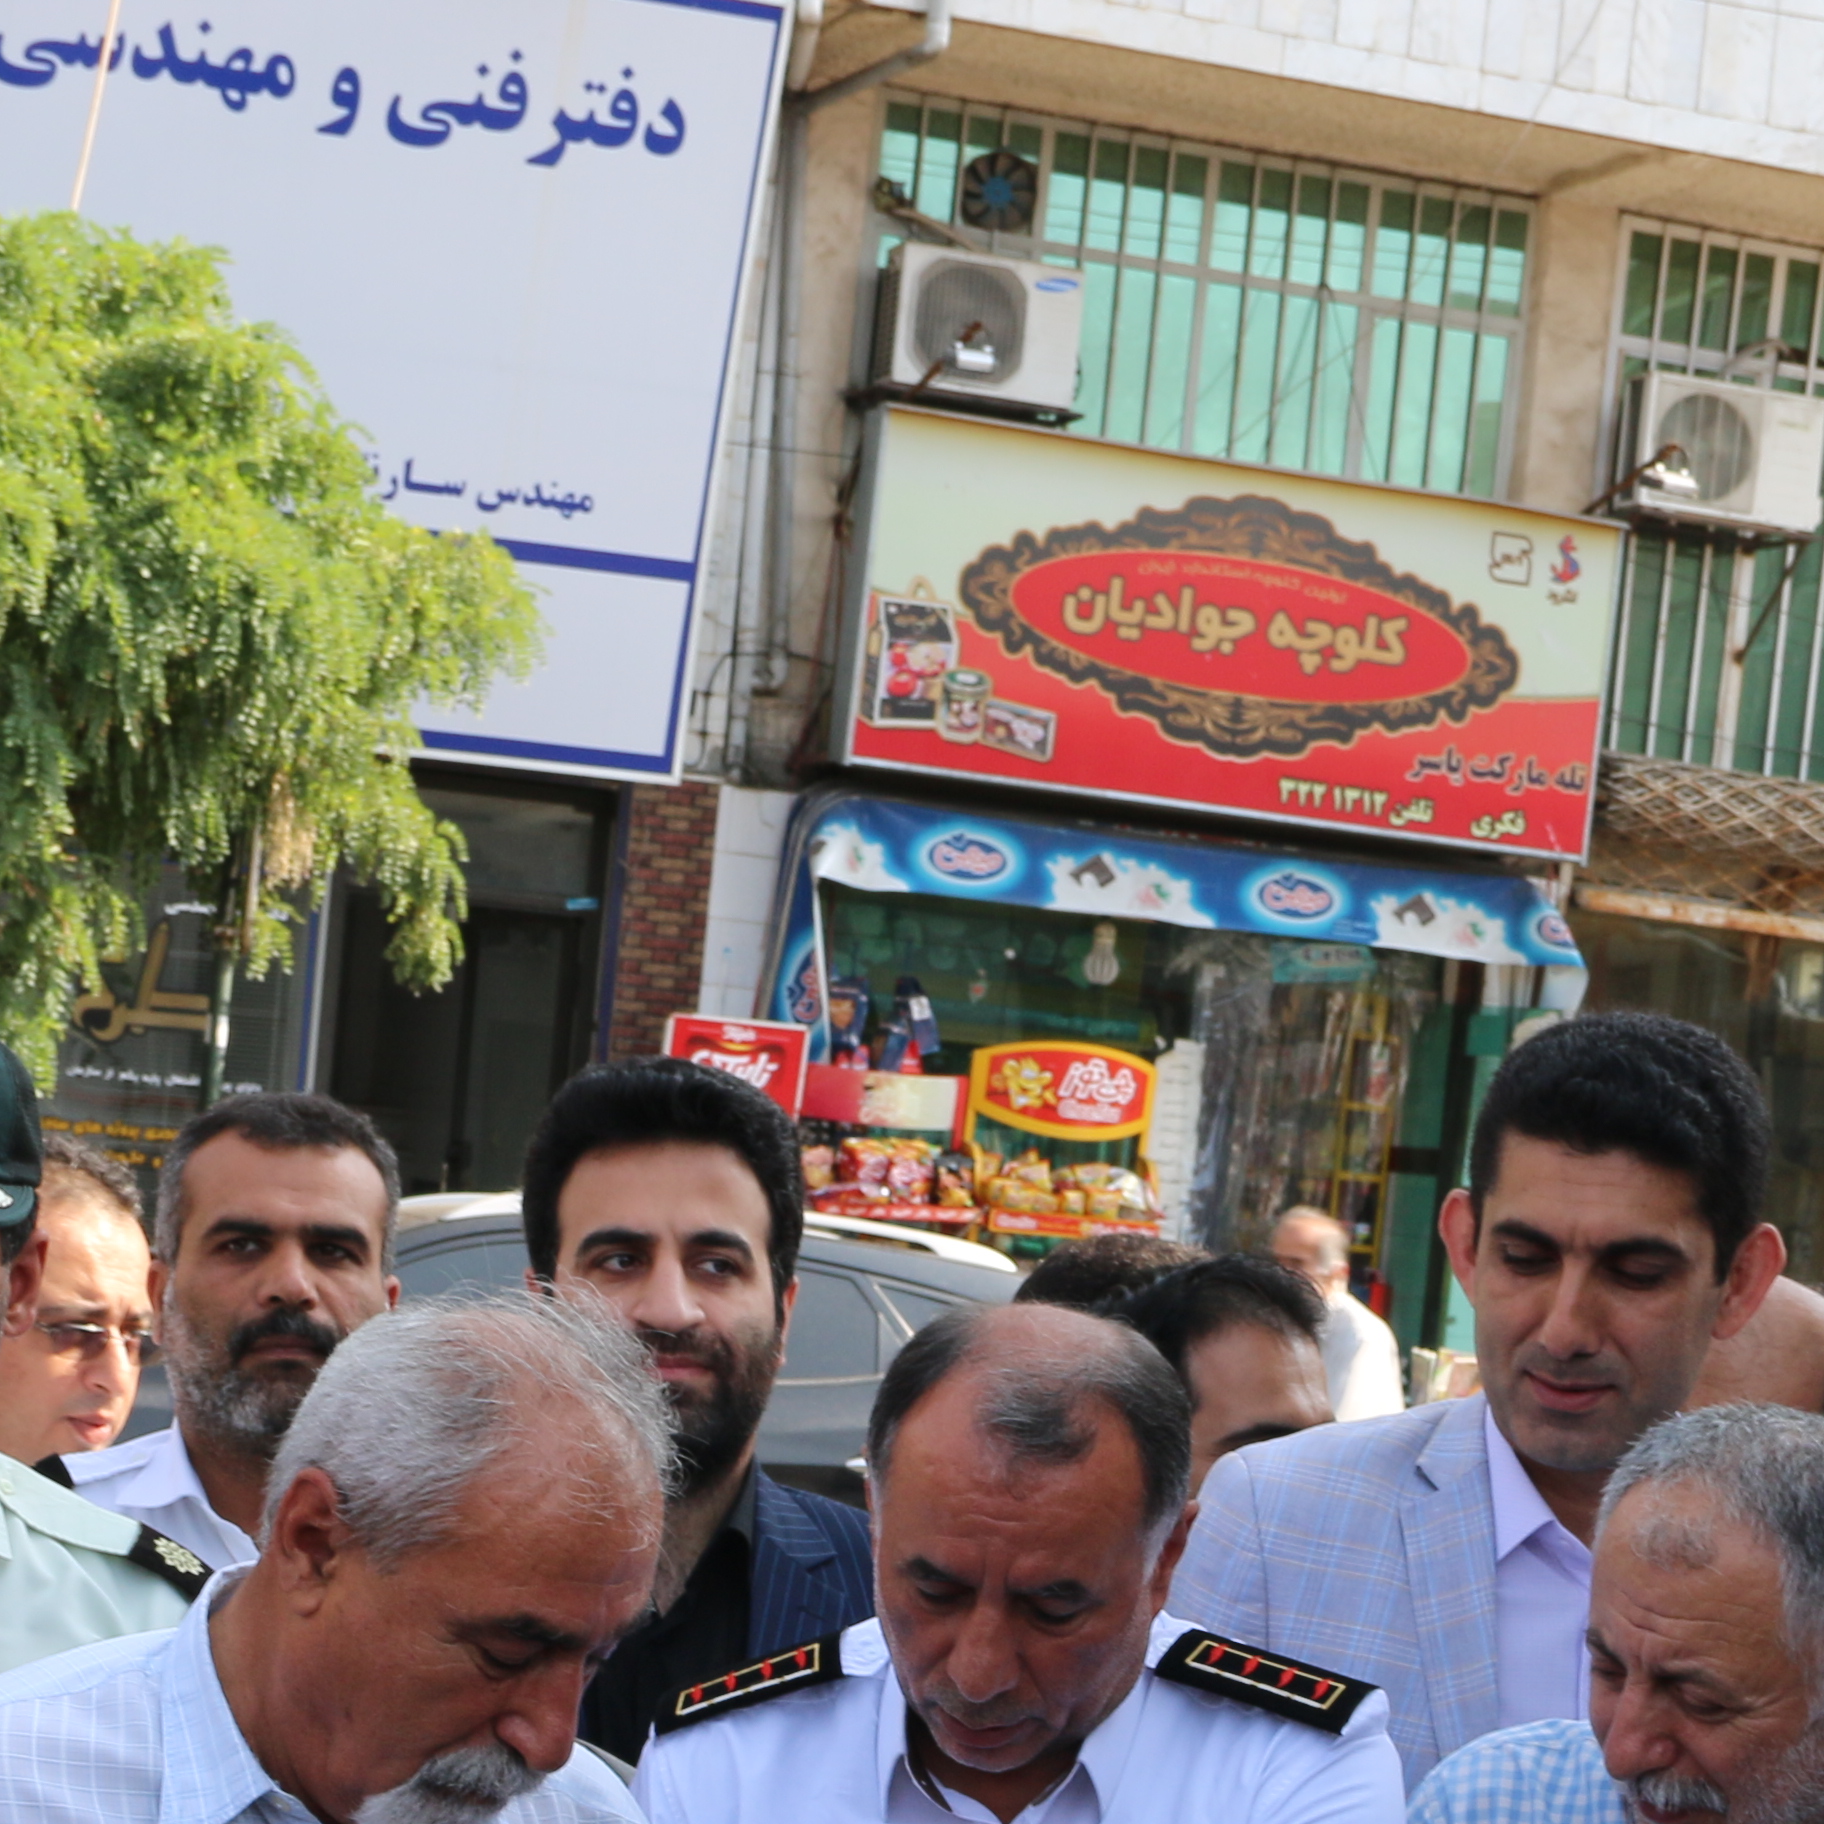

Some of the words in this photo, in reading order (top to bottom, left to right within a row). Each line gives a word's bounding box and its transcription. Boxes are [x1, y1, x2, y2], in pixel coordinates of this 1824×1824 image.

[316, 66, 363, 137] و
[387, 48, 530, 148] فنی
[525, 66, 686, 168] دفتر
[475, 481, 594, 519] مهندس
[1060, 574, 1258, 656] جوادیان
[1266, 610, 1411, 677] کلوچه
[1404, 746, 1466, 786] یاسر
[1468, 752, 1552, 796] مارکت
[1388, 796, 1436, 828] تلفن
[1469, 809, 1529, 840] فکری
